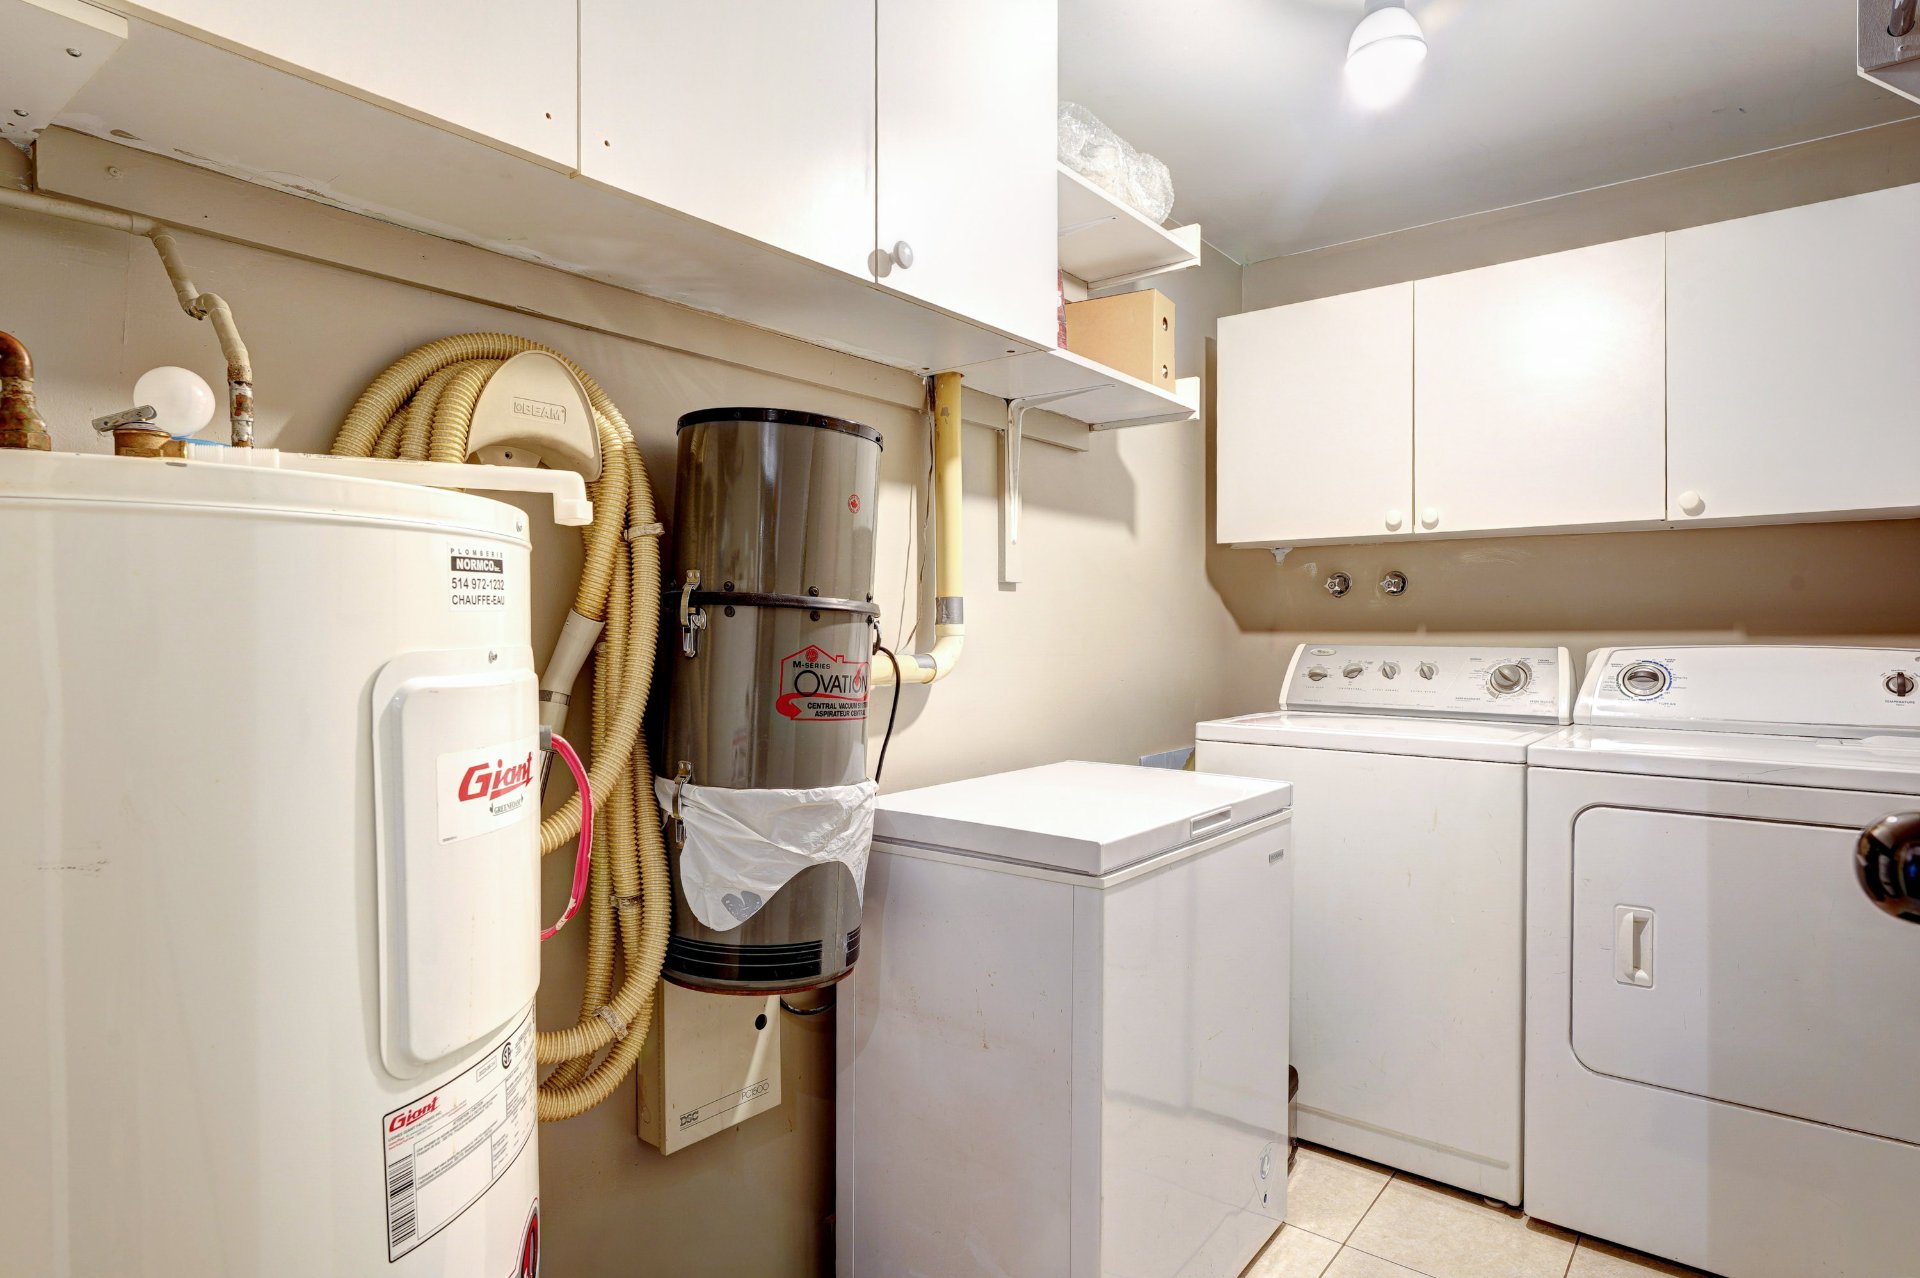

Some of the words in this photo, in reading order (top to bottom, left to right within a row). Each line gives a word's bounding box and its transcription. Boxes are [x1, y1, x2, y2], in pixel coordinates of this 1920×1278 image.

[456, 558, 494, 571] NORMCO
[452, 577, 469, 589] 514
[471, 578, 504, 590] 972-1232
[452, 594, 504, 605] CHAUFFE-EAU
[793, 661, 831, 670] M-SERIES
[794, 670, 867, 697] OVATION
[807, 702, 837, 710] CENTRAL
[814, 710, 850, 718] ASPIRATEUR
[458, 752, 532, 801] Giant
[389, 1096, 438, 1132] Giant
[679, 1110, 699, 1127] DSC
